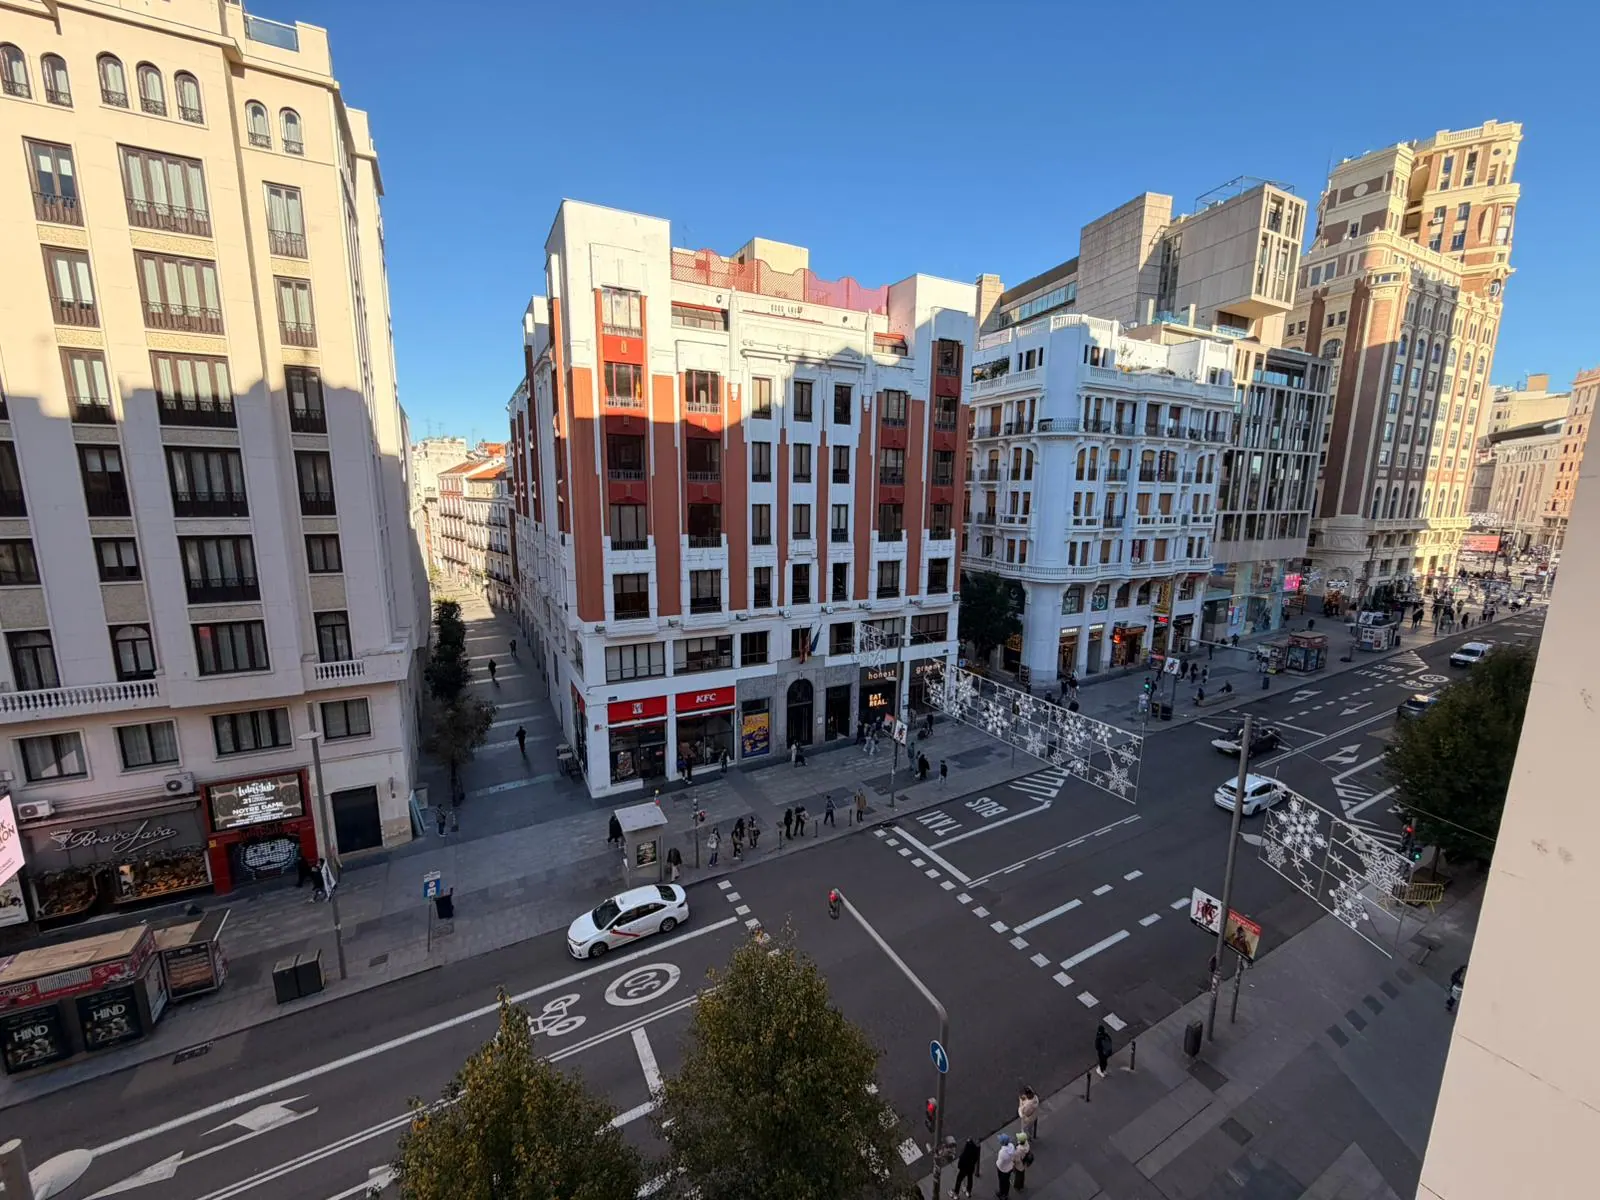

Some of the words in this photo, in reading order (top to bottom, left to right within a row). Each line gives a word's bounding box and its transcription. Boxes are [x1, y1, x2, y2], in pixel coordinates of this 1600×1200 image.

[868, 670, 895, 680] honest
[696, 693, 716, 703] KFC
[232, 806, 260, 814] NOTRE
[261, 801, 284, 809] DAME
[965, 797, 1008, 817] BUS
[916, 810, 962, 836] TAXI
[624, 971, 661, 997] 30
[93, 1003, 126, 1021] HIND
[13, 1024, 49, 1042] HIND
